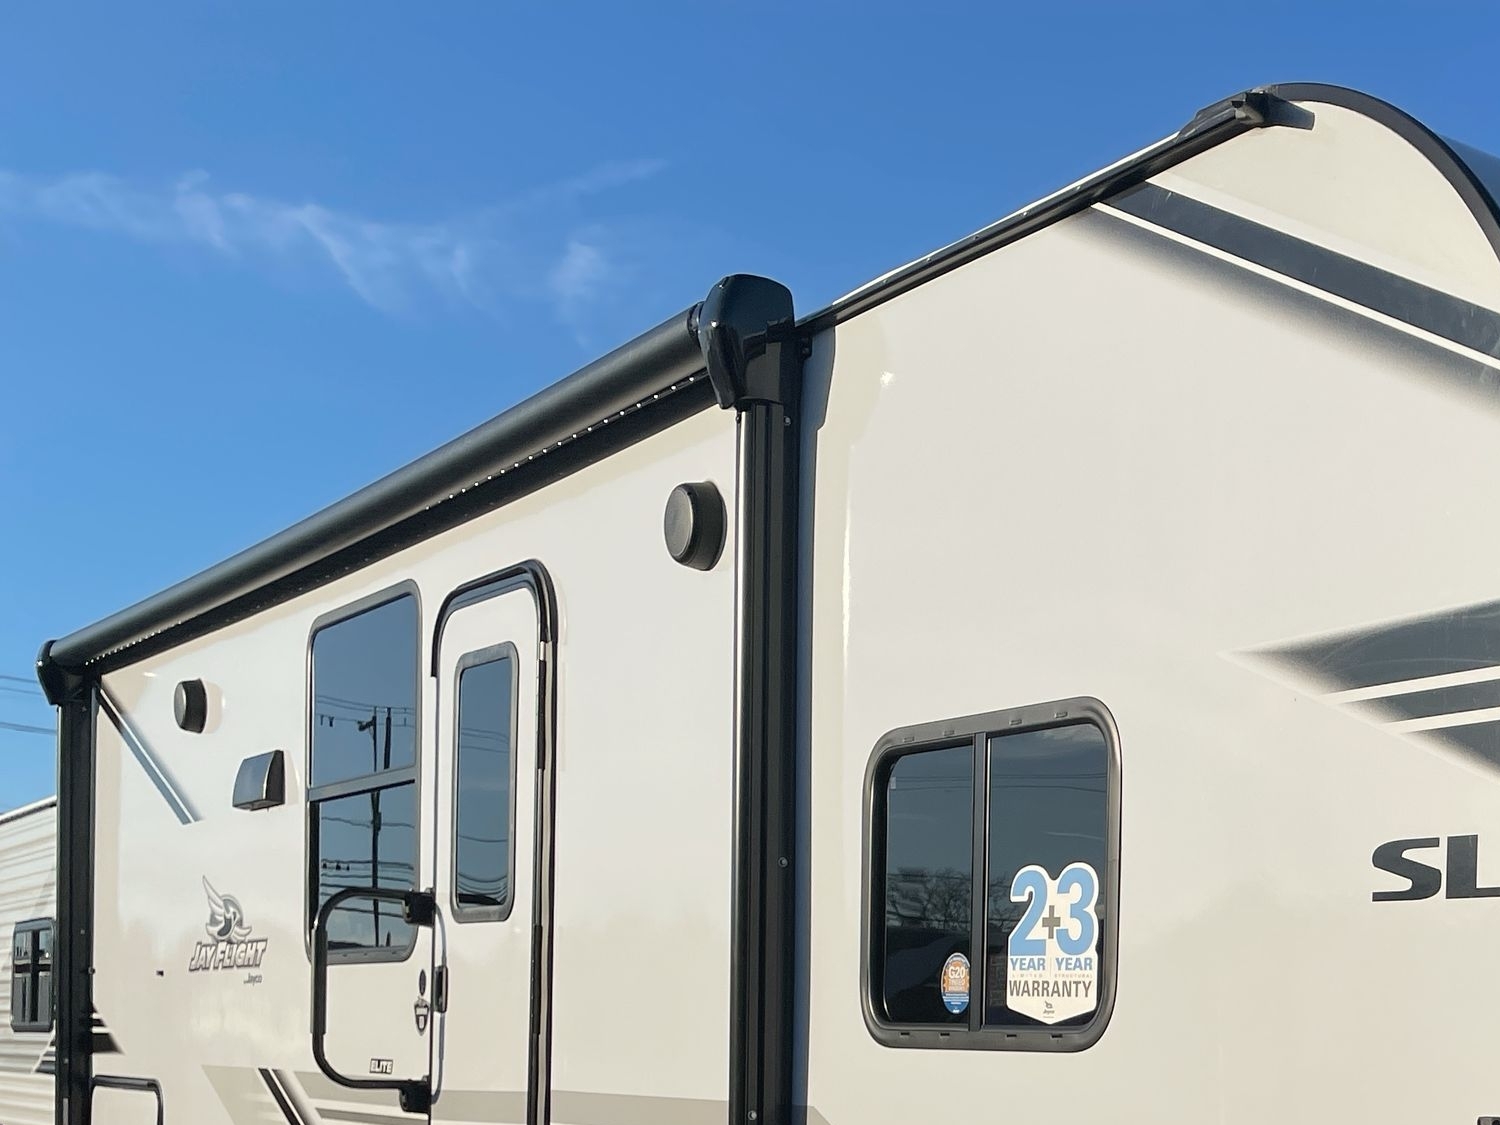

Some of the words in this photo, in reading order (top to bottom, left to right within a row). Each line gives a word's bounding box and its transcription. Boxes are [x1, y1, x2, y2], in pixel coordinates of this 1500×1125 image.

[189, 942, 216, 972] JAY
[213, 937, 268, 970] FLIGHT
[1010, 957, 1046, 971] YEAR
[1055, 957, 1093, 971] YEAR
[1009, 980, 1092, 998] WARRANTY
